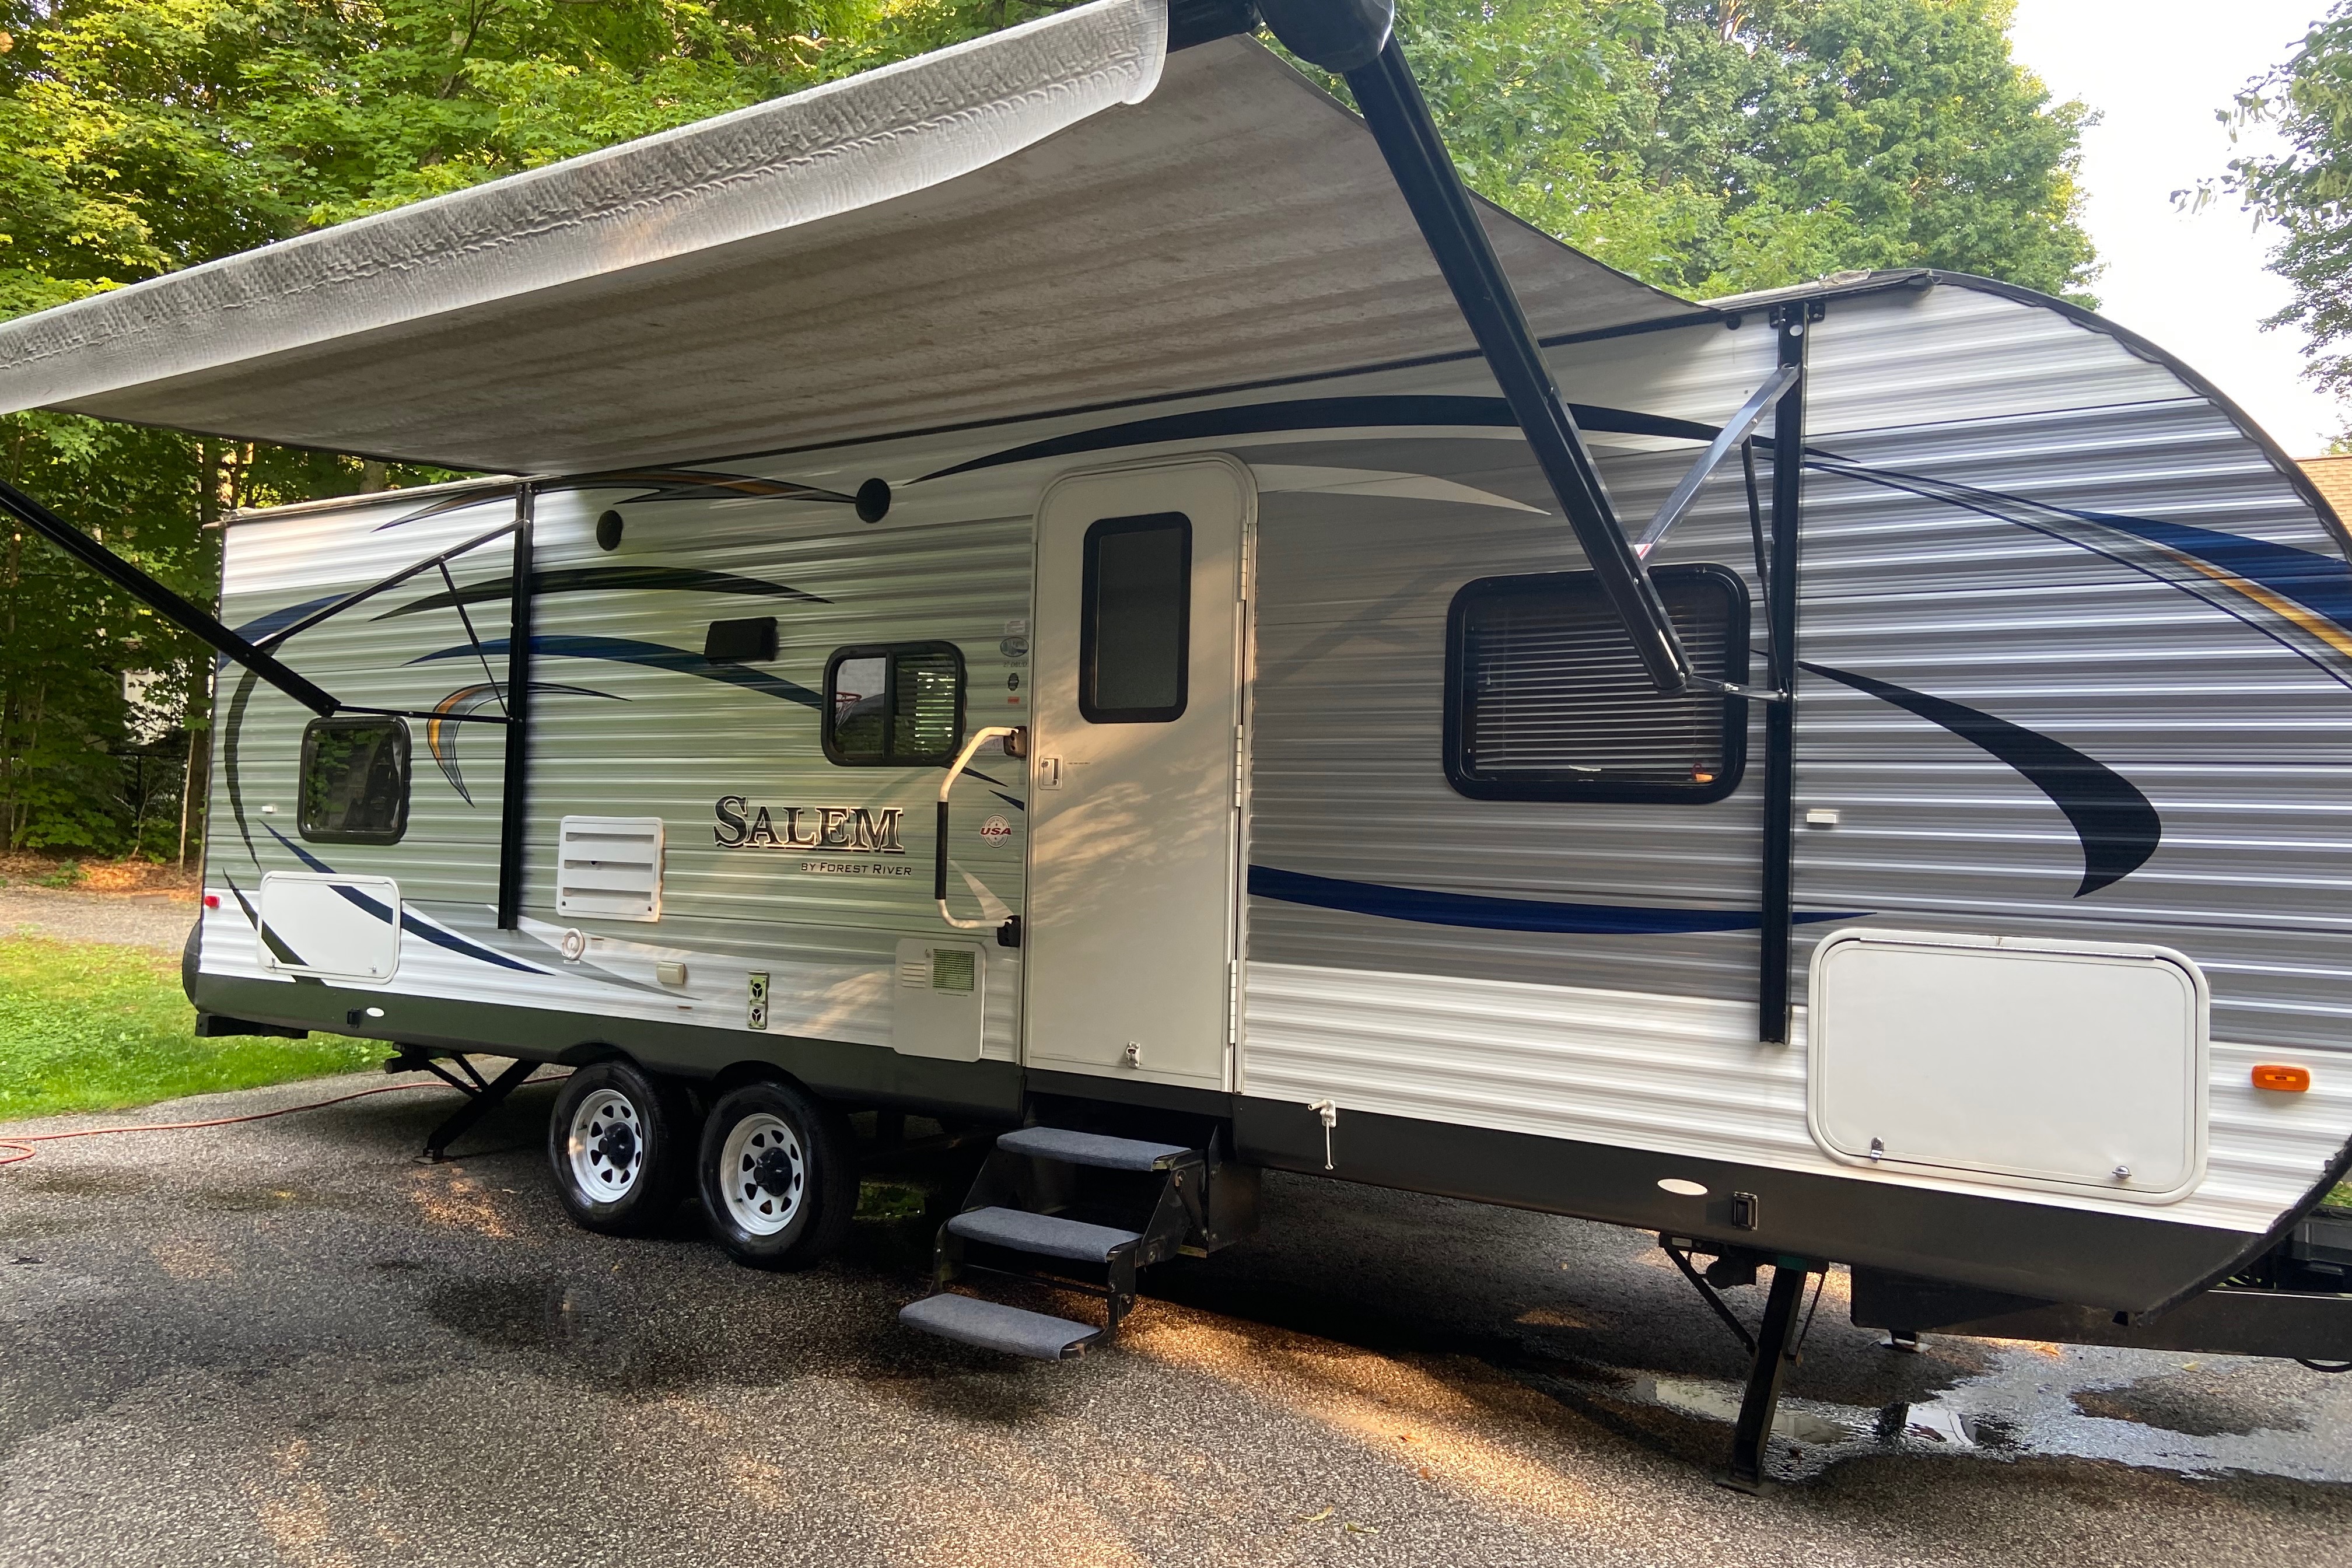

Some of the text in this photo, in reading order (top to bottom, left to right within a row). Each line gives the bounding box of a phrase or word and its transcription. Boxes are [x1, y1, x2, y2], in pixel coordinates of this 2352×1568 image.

[713, 794, 905, 853] SALEM
[980, 827, 1012, 835] USA
[820, 862, 868, 873] FOREST
[873, 864, 912, 875] RIVER
